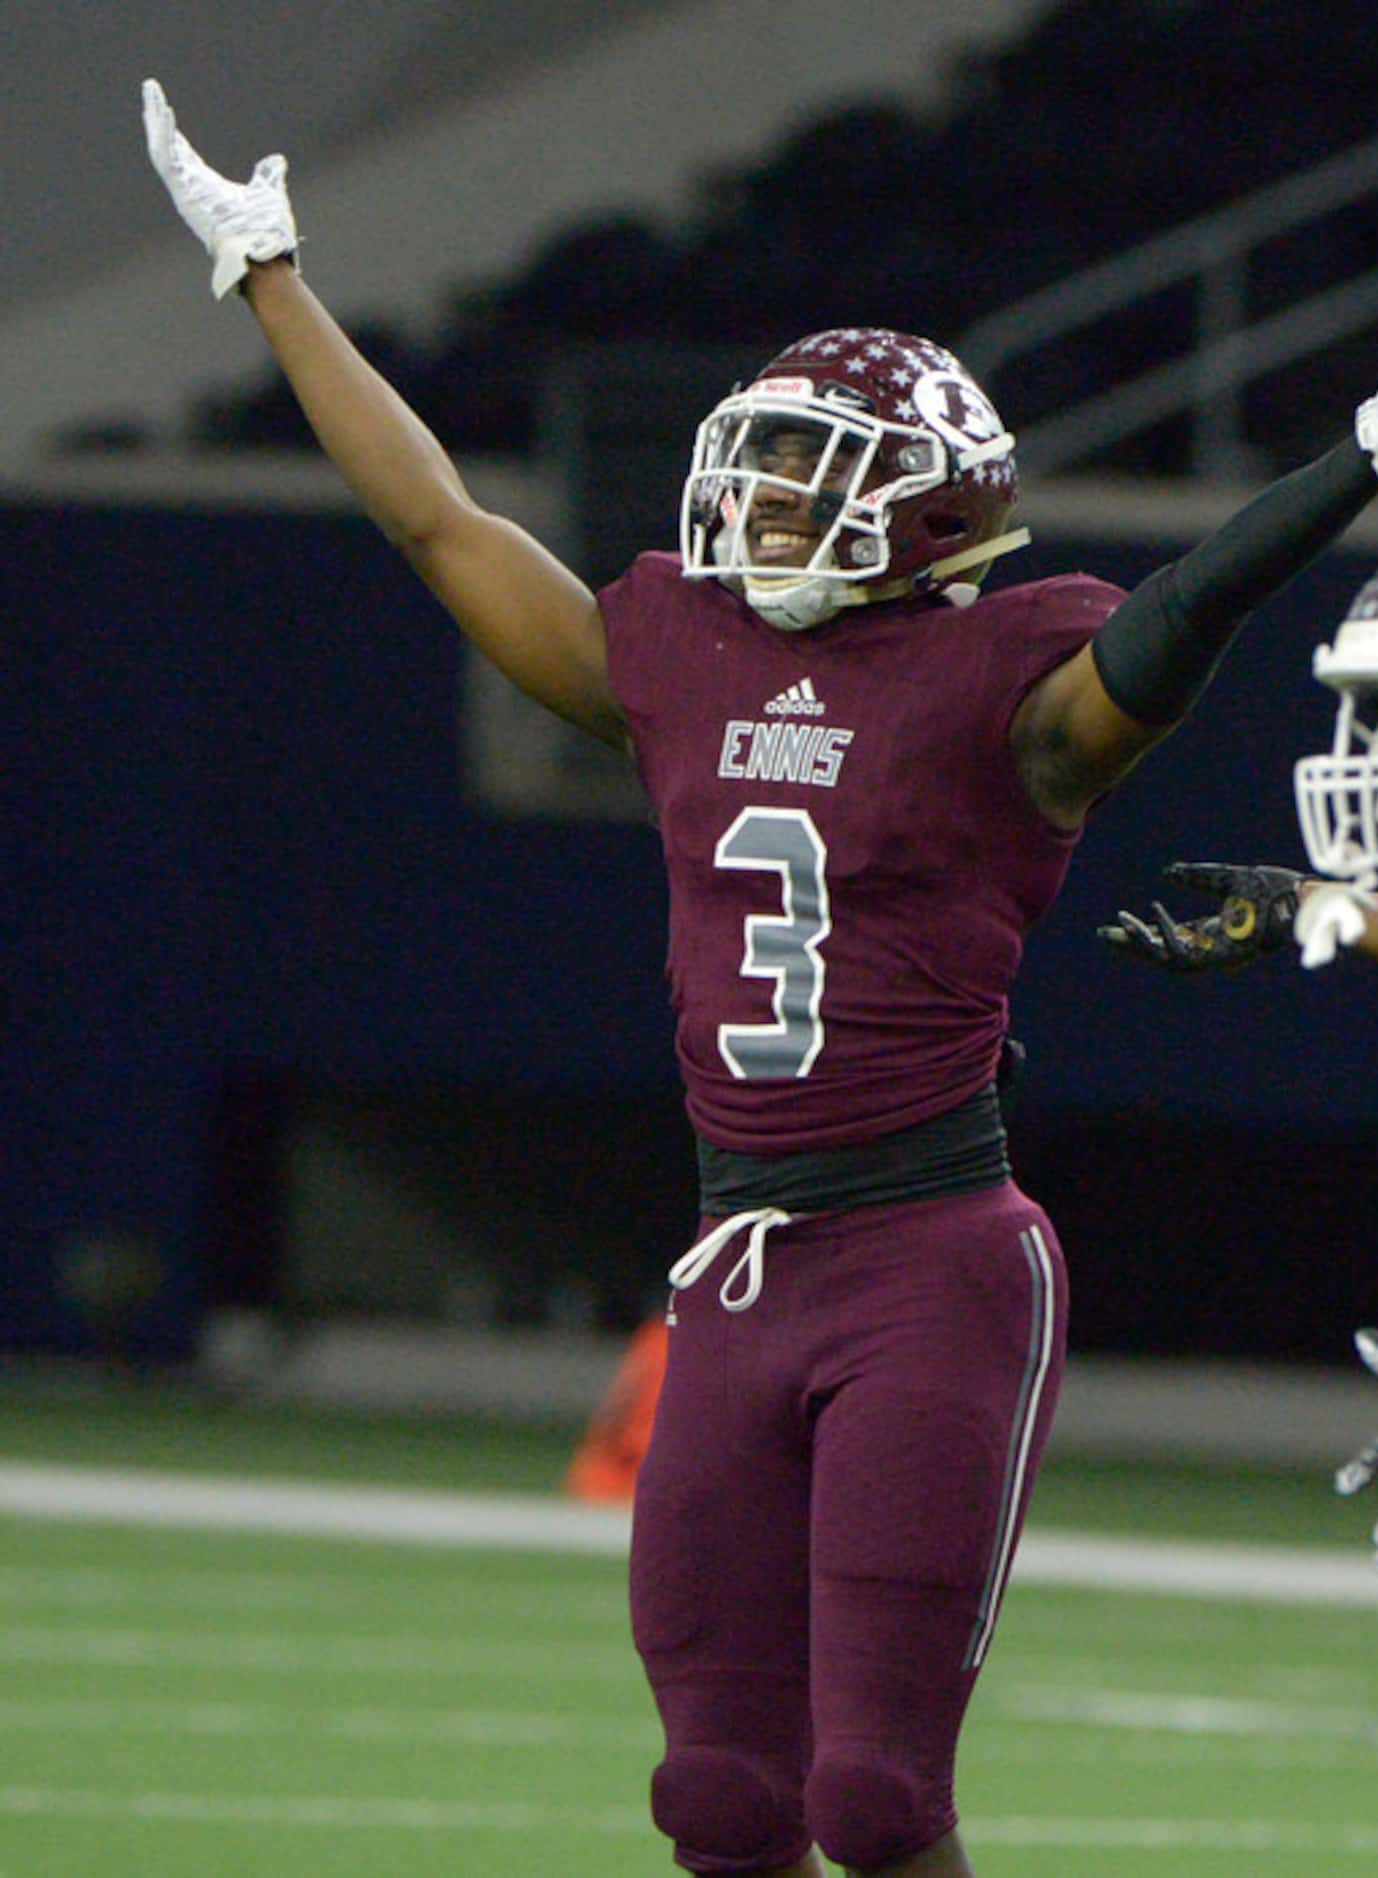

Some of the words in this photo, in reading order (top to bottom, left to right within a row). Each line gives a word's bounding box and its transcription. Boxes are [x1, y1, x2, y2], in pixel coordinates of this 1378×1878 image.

[764, 698, 827, 717] adidas
[717, 719, 855, 788] ENNIS
[713, 805, 832, 1080] 3
